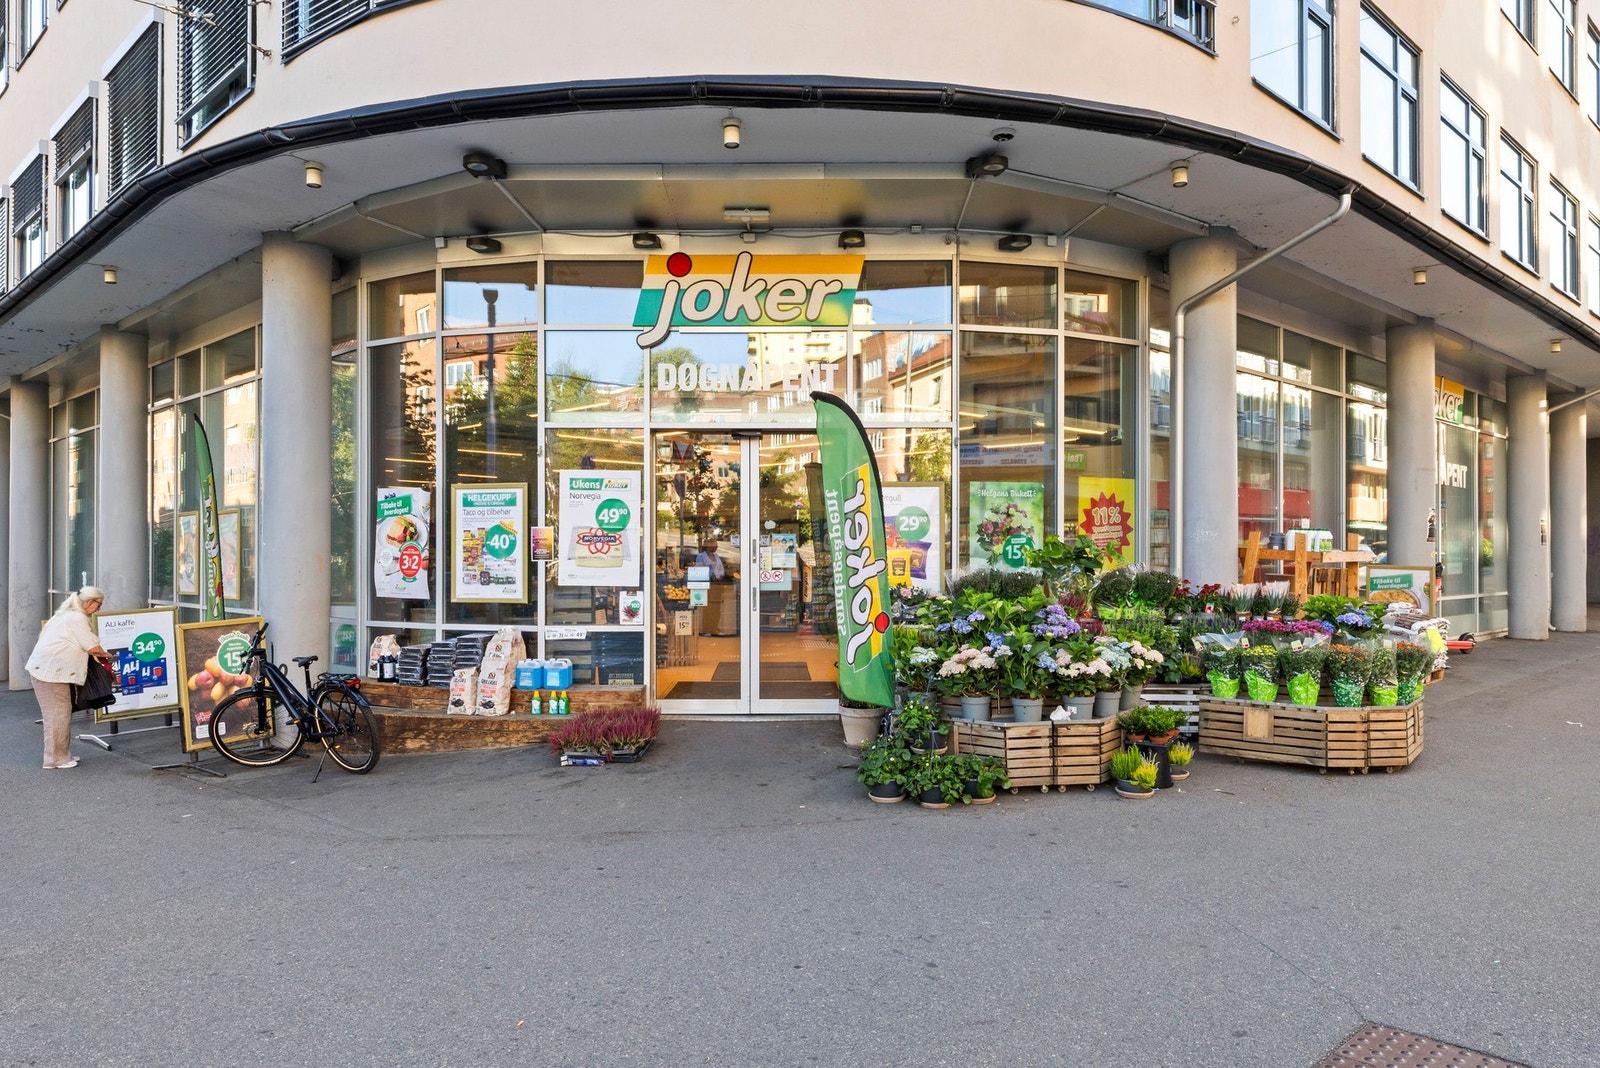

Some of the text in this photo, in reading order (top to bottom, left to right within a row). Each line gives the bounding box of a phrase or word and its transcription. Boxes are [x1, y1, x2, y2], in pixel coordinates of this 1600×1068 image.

[636, 251, 843, 348] joker
[658, 362, 839, 392] DØGNÅPENT
[573, 480, 600, 489] Ukens
[570, 493, 601, 501] Norvegia
[982, 489, 1008, 497] Helgens
[467, 494, 511, 502] HELGEKUPP
[487, 508, 511, 516] tilbehør
[1005, 544, 1023, 559] 15
[411, 555, 419, 569] 2
[117, 619, 135, 627] kaffe
[224, 651, 242, 667] 15
